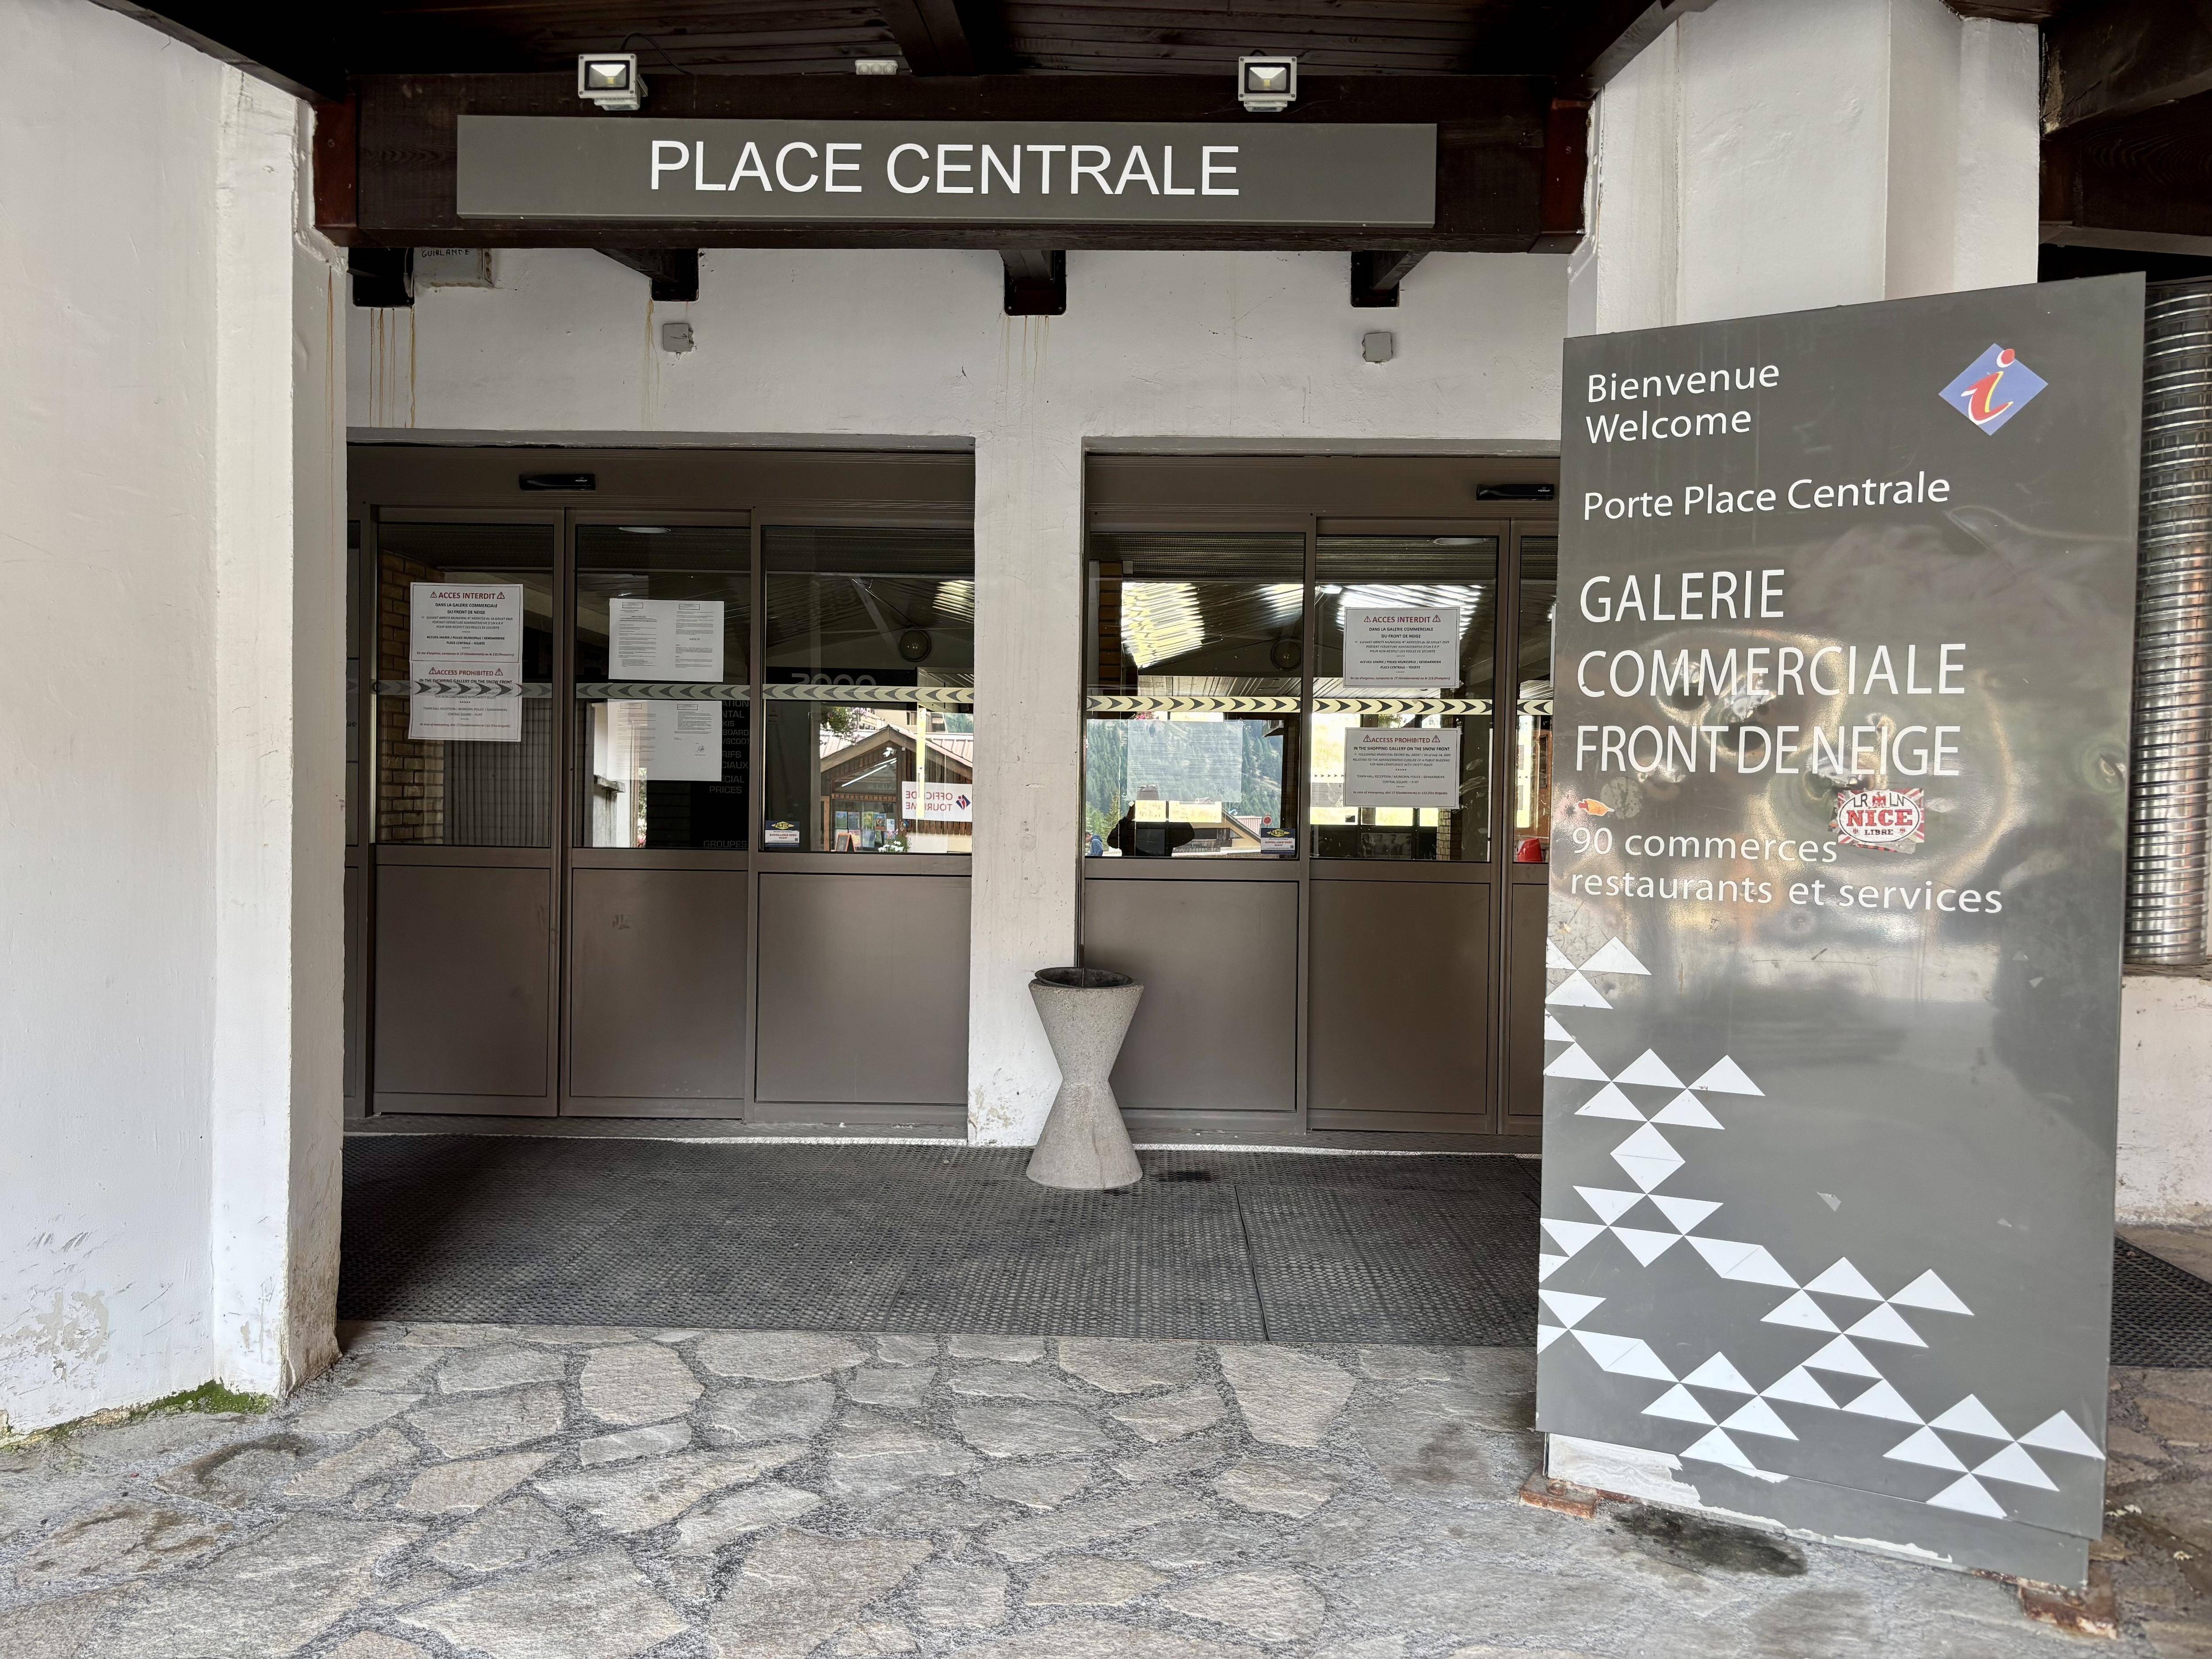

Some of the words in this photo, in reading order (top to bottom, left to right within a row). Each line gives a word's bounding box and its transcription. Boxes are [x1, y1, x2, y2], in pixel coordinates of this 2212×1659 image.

[651, 140, 862, 193] PLACE
[887, 143, 1240, 196] CENTRALE
[1588, 365, 1779, 403] Bienvenue
[1585, 410, 1751, 444] Welcome
[1584, 492, 1673, 520] Porte
[1684, 484, 1776, 515] Place
[1787, 471, 1950, 509] Centrale
[1580, 569, 1785, 622] GALERIE
[1577, 643, 1966, 698] COMMERCIALE
[1576, 725, 1729, 773] FRONT
[1738, 726, 1800, 774] DE
[1813, 726, 1961, 776] NEIGE
[1846, 809, 1913, 827] NICE
[1573, 827, 1613, 855] 90
[1625, 835, 1837, 863] commerces
[1571, 872, 1772, 904] restaurants
[1789, 879, 1825, 906] et
[1839, 880, 2003, 914] services
